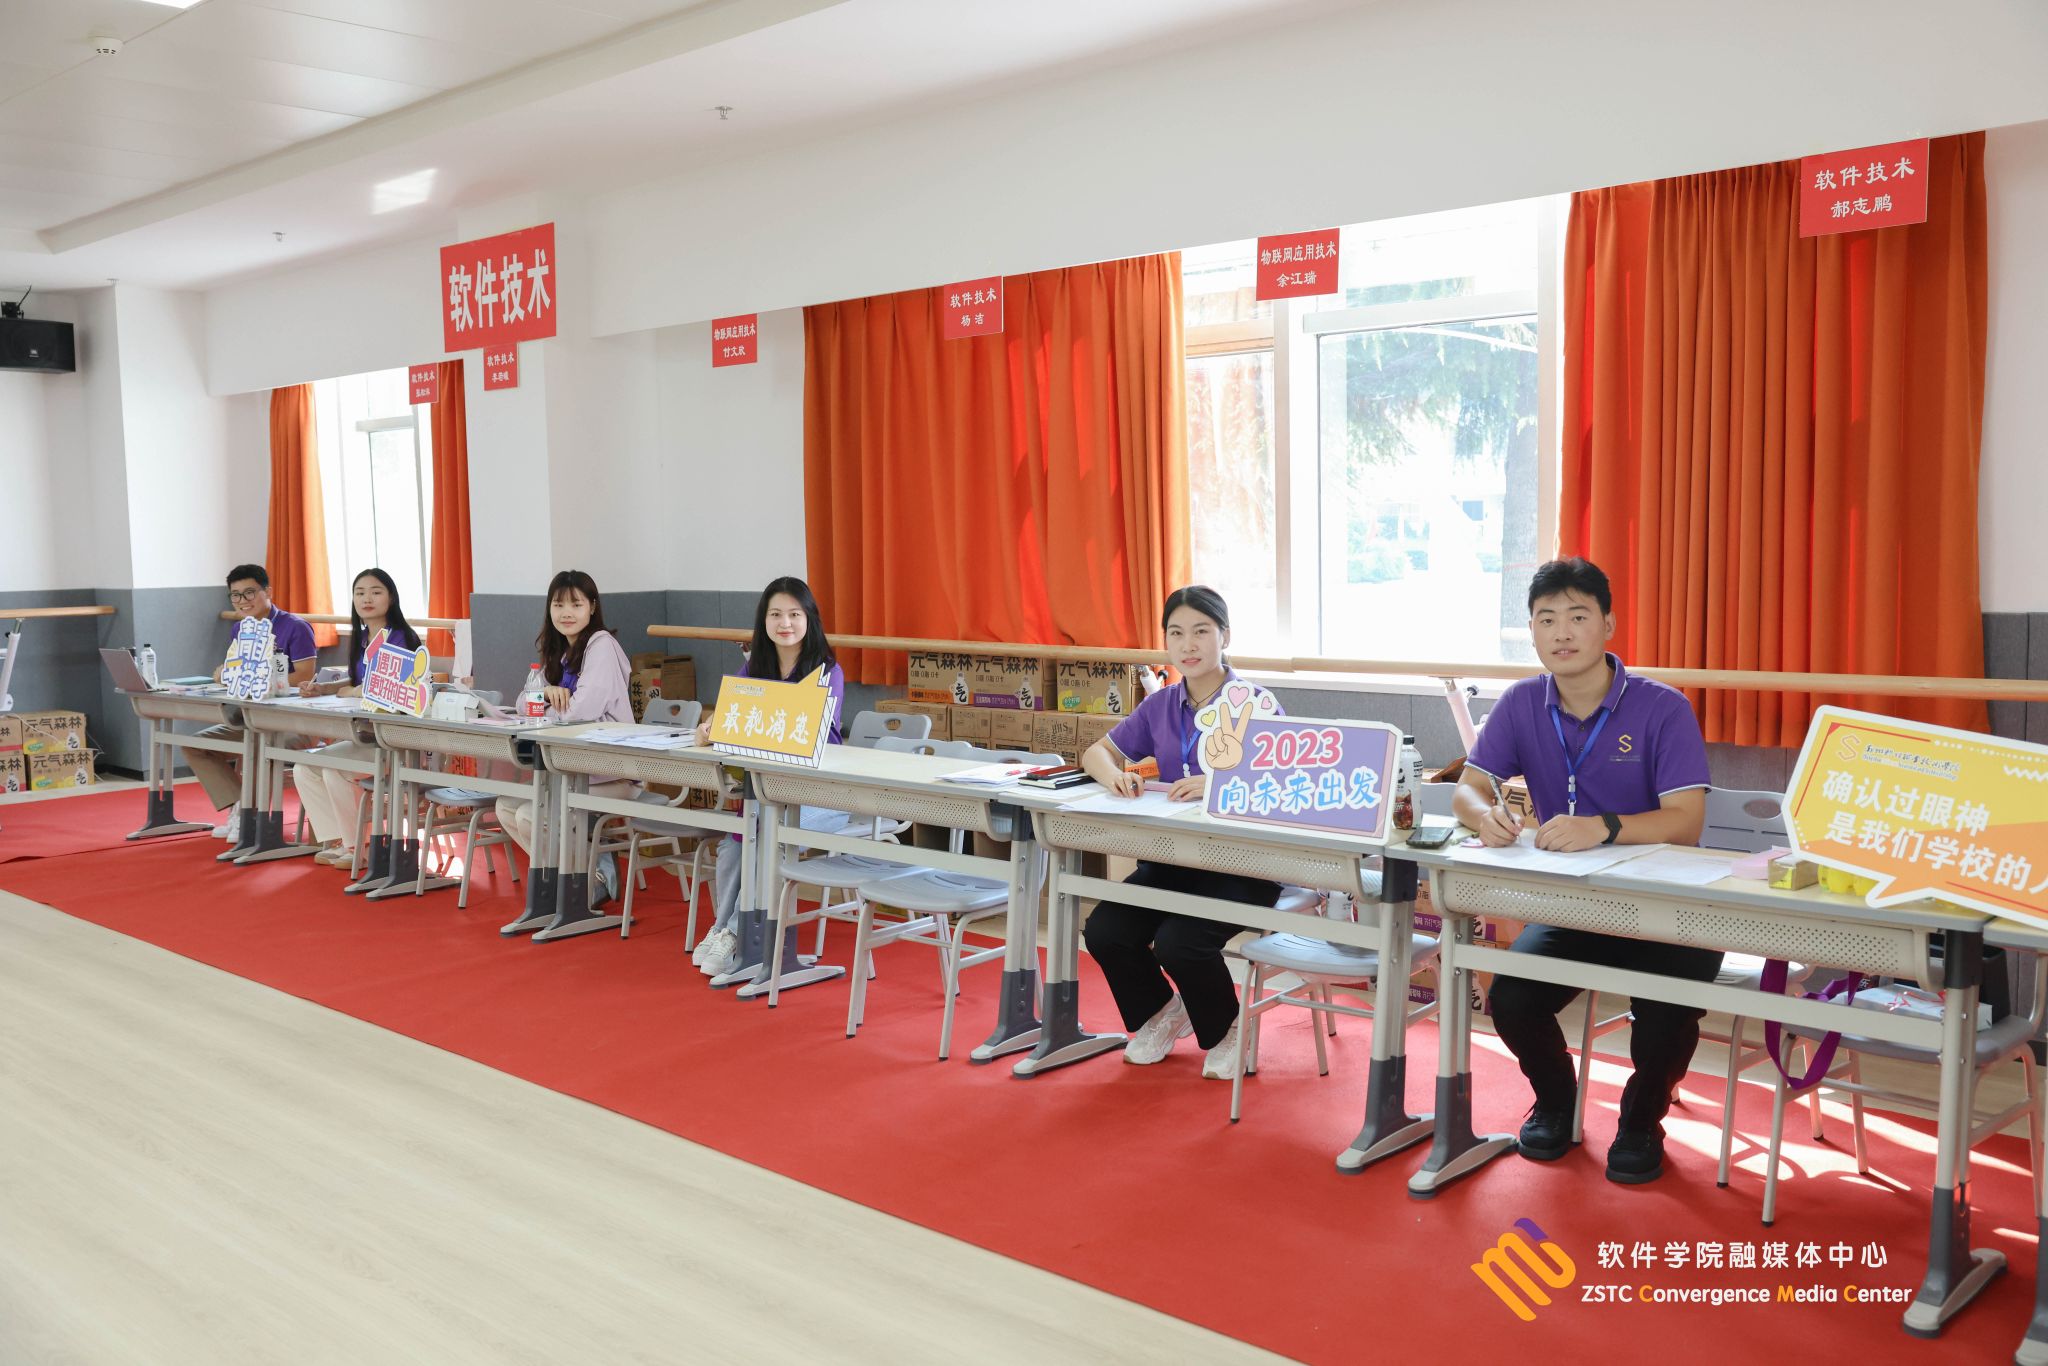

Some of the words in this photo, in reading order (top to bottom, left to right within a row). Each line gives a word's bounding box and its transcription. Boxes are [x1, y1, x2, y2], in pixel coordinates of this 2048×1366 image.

[1814, 157, 1915, 190] 软件技术
[1831, 194, 1892, 218] 郝志鹏
[1261, 241, 1336, 265] 物联网应用技术
[449, 248, 551, 332] 软件技术
[950, 287, 996, 308] 软件技术
[486, 352, 514, 366] 软件技术
[377, 652, 402, 680] 遇见
[911, 650, 972, 671] 元气森林
[975, 655, 1038, 674] 元气森林
[1060, 660, 1126, 679] 元气森林
[369, 673, 417, 710] 更好的自己
[26, 716, 81, 732] 元气森林
[34, 752, 91, 768] 元气森林
[1251, 730, 1342, 768] 2023
[1220, 770, 1381, 812] 向未来出发
[1822, 770, 1990, 836] 确认过眼神
